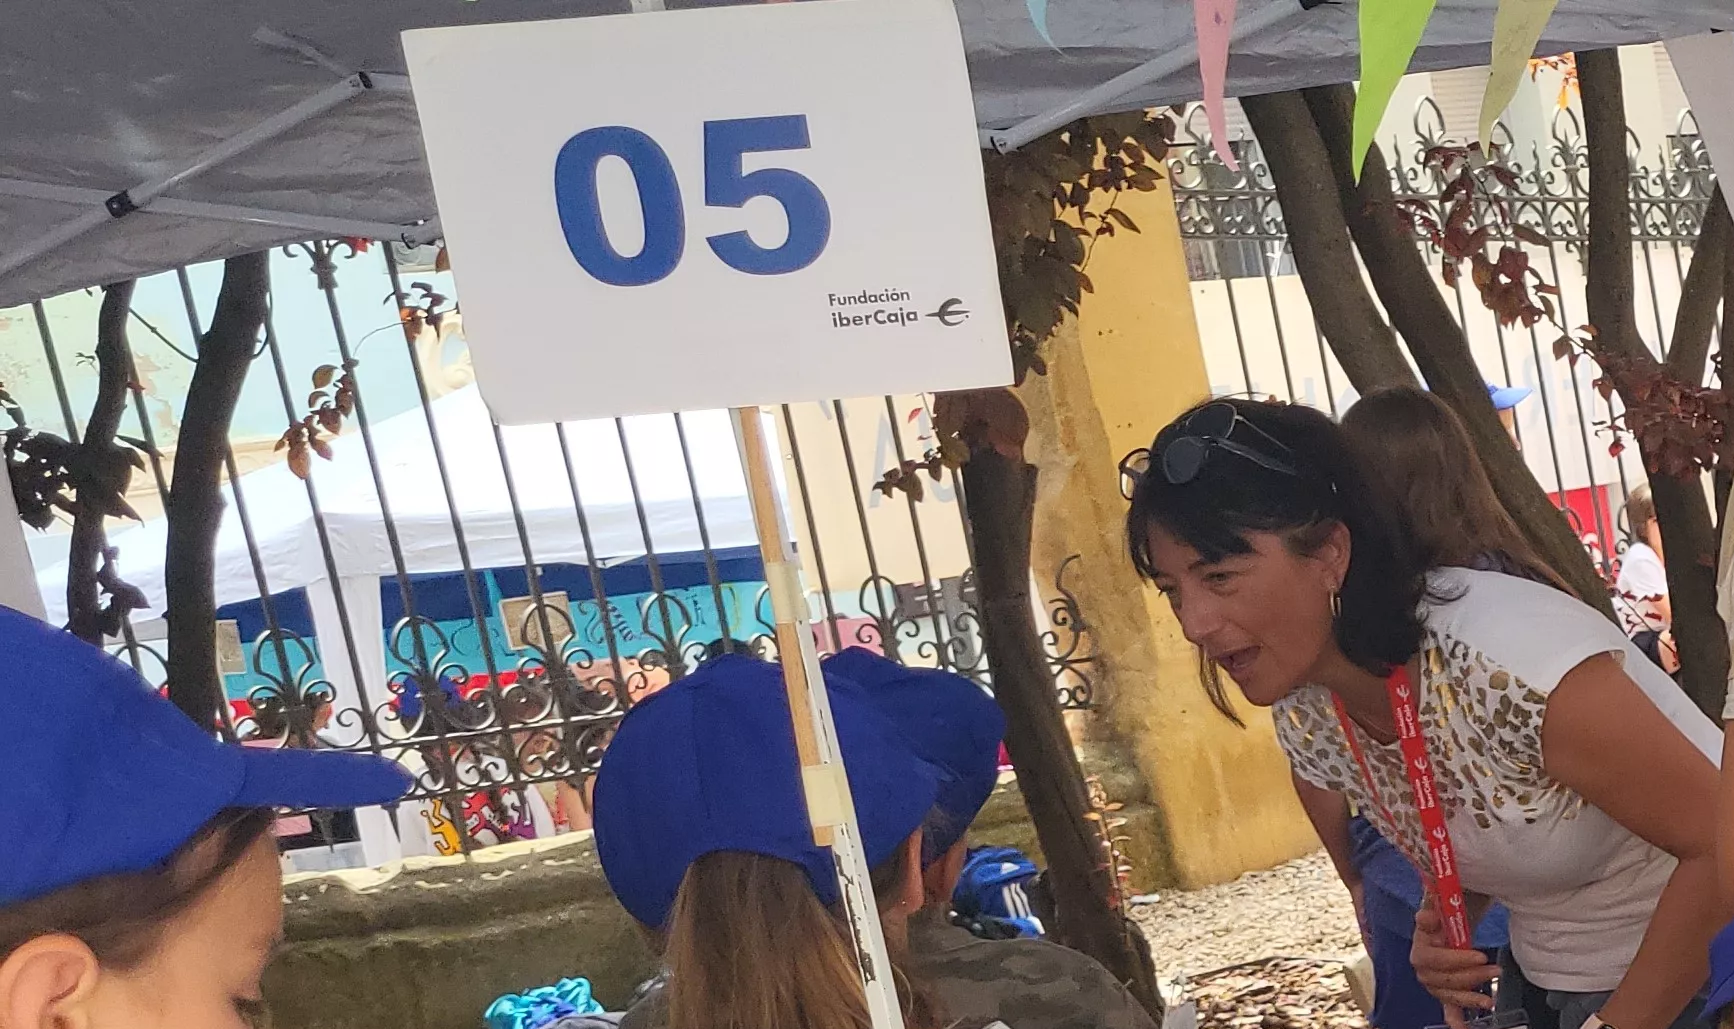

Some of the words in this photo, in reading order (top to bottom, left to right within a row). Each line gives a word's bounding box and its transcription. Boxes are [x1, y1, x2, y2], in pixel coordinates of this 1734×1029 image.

[554, 113, 832, 287] 05
[828, 288, 911, 307] Fundación
[831, 307, 919, 328] iberCaja
